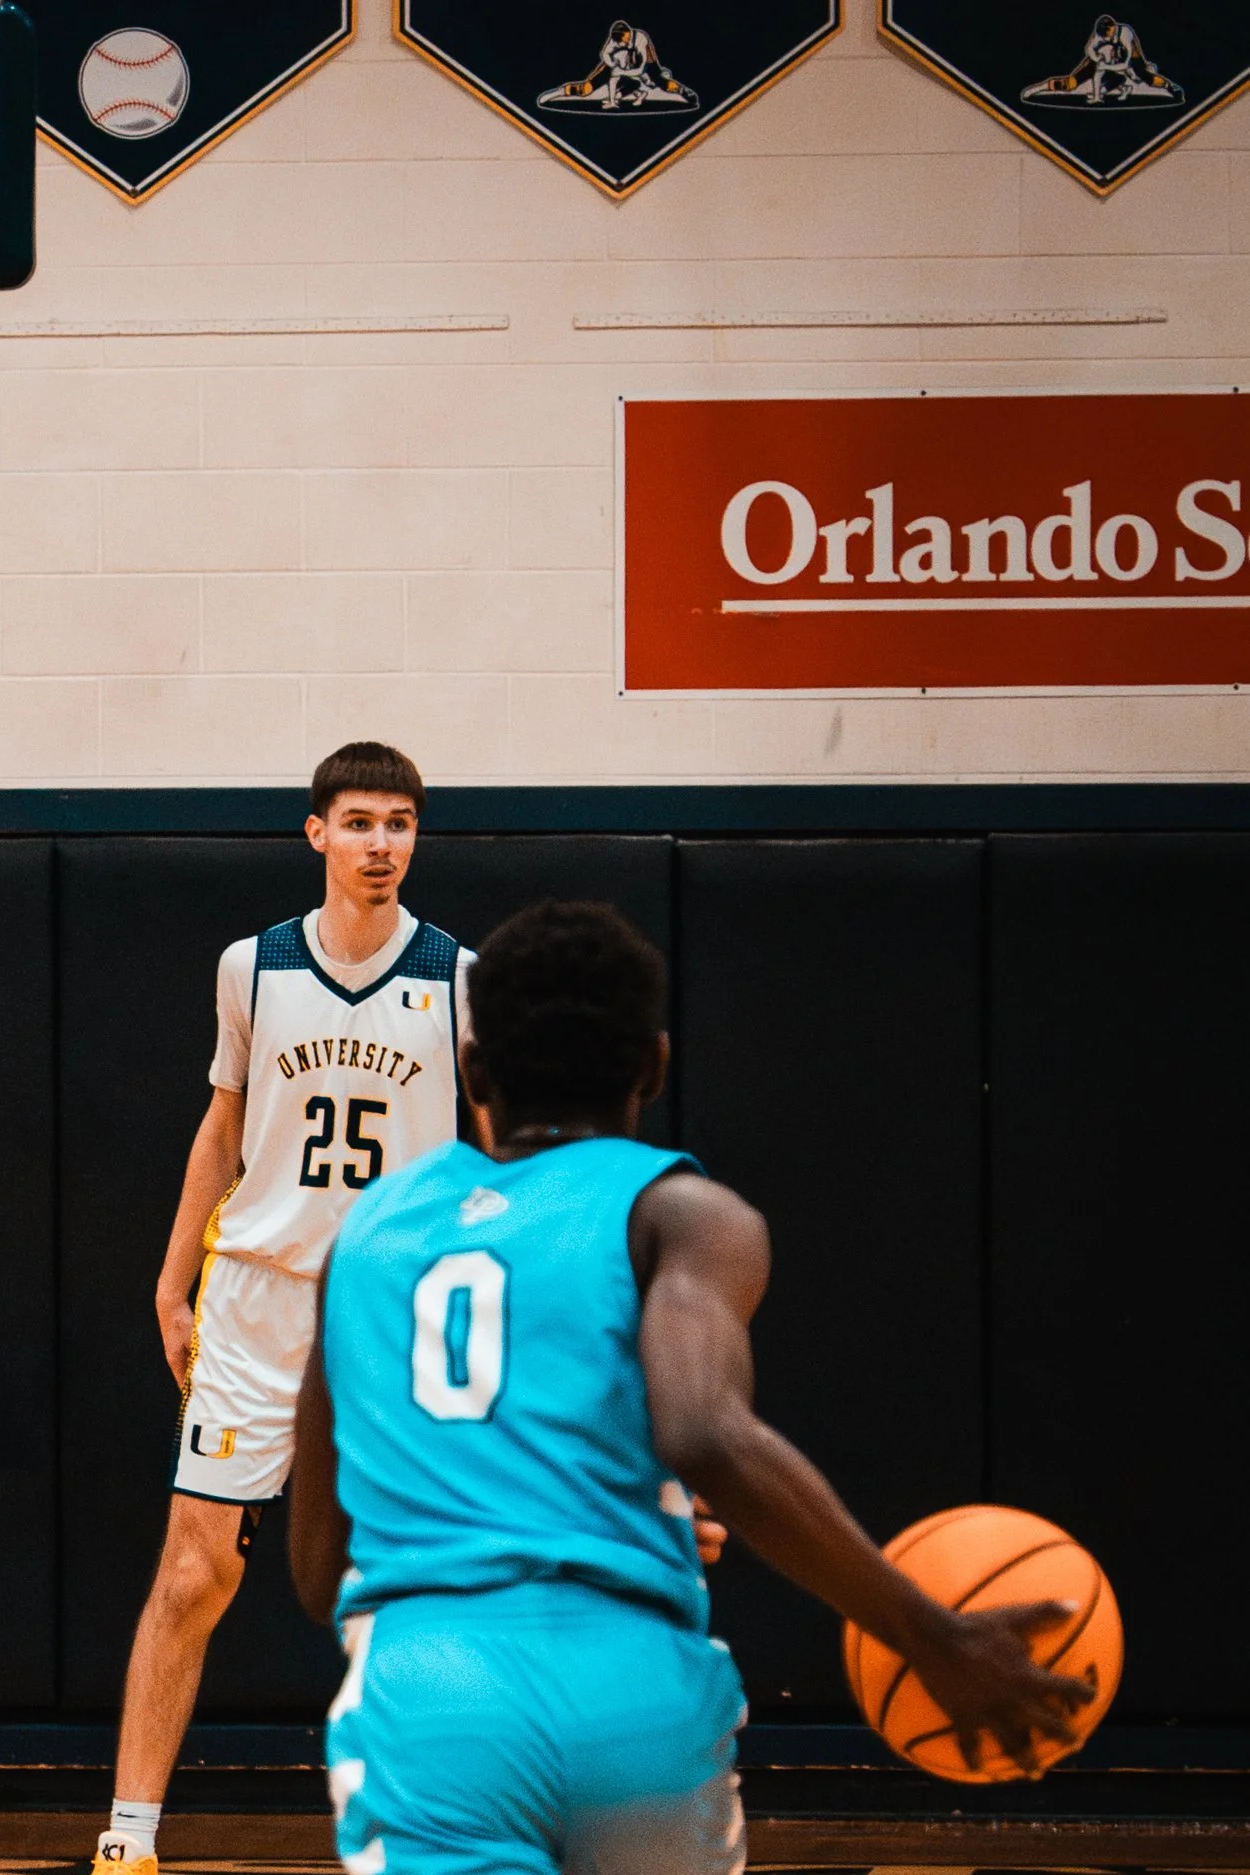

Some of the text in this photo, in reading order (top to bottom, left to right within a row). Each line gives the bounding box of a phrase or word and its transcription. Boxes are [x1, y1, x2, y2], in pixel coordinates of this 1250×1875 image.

[721, 479, 1250, 584] Orlando S
[278, 1038, 422, 1086] UNIVERSITY
[300, 1095, 388, 1190] 25
[410, 1249, 508, 1421] 0
